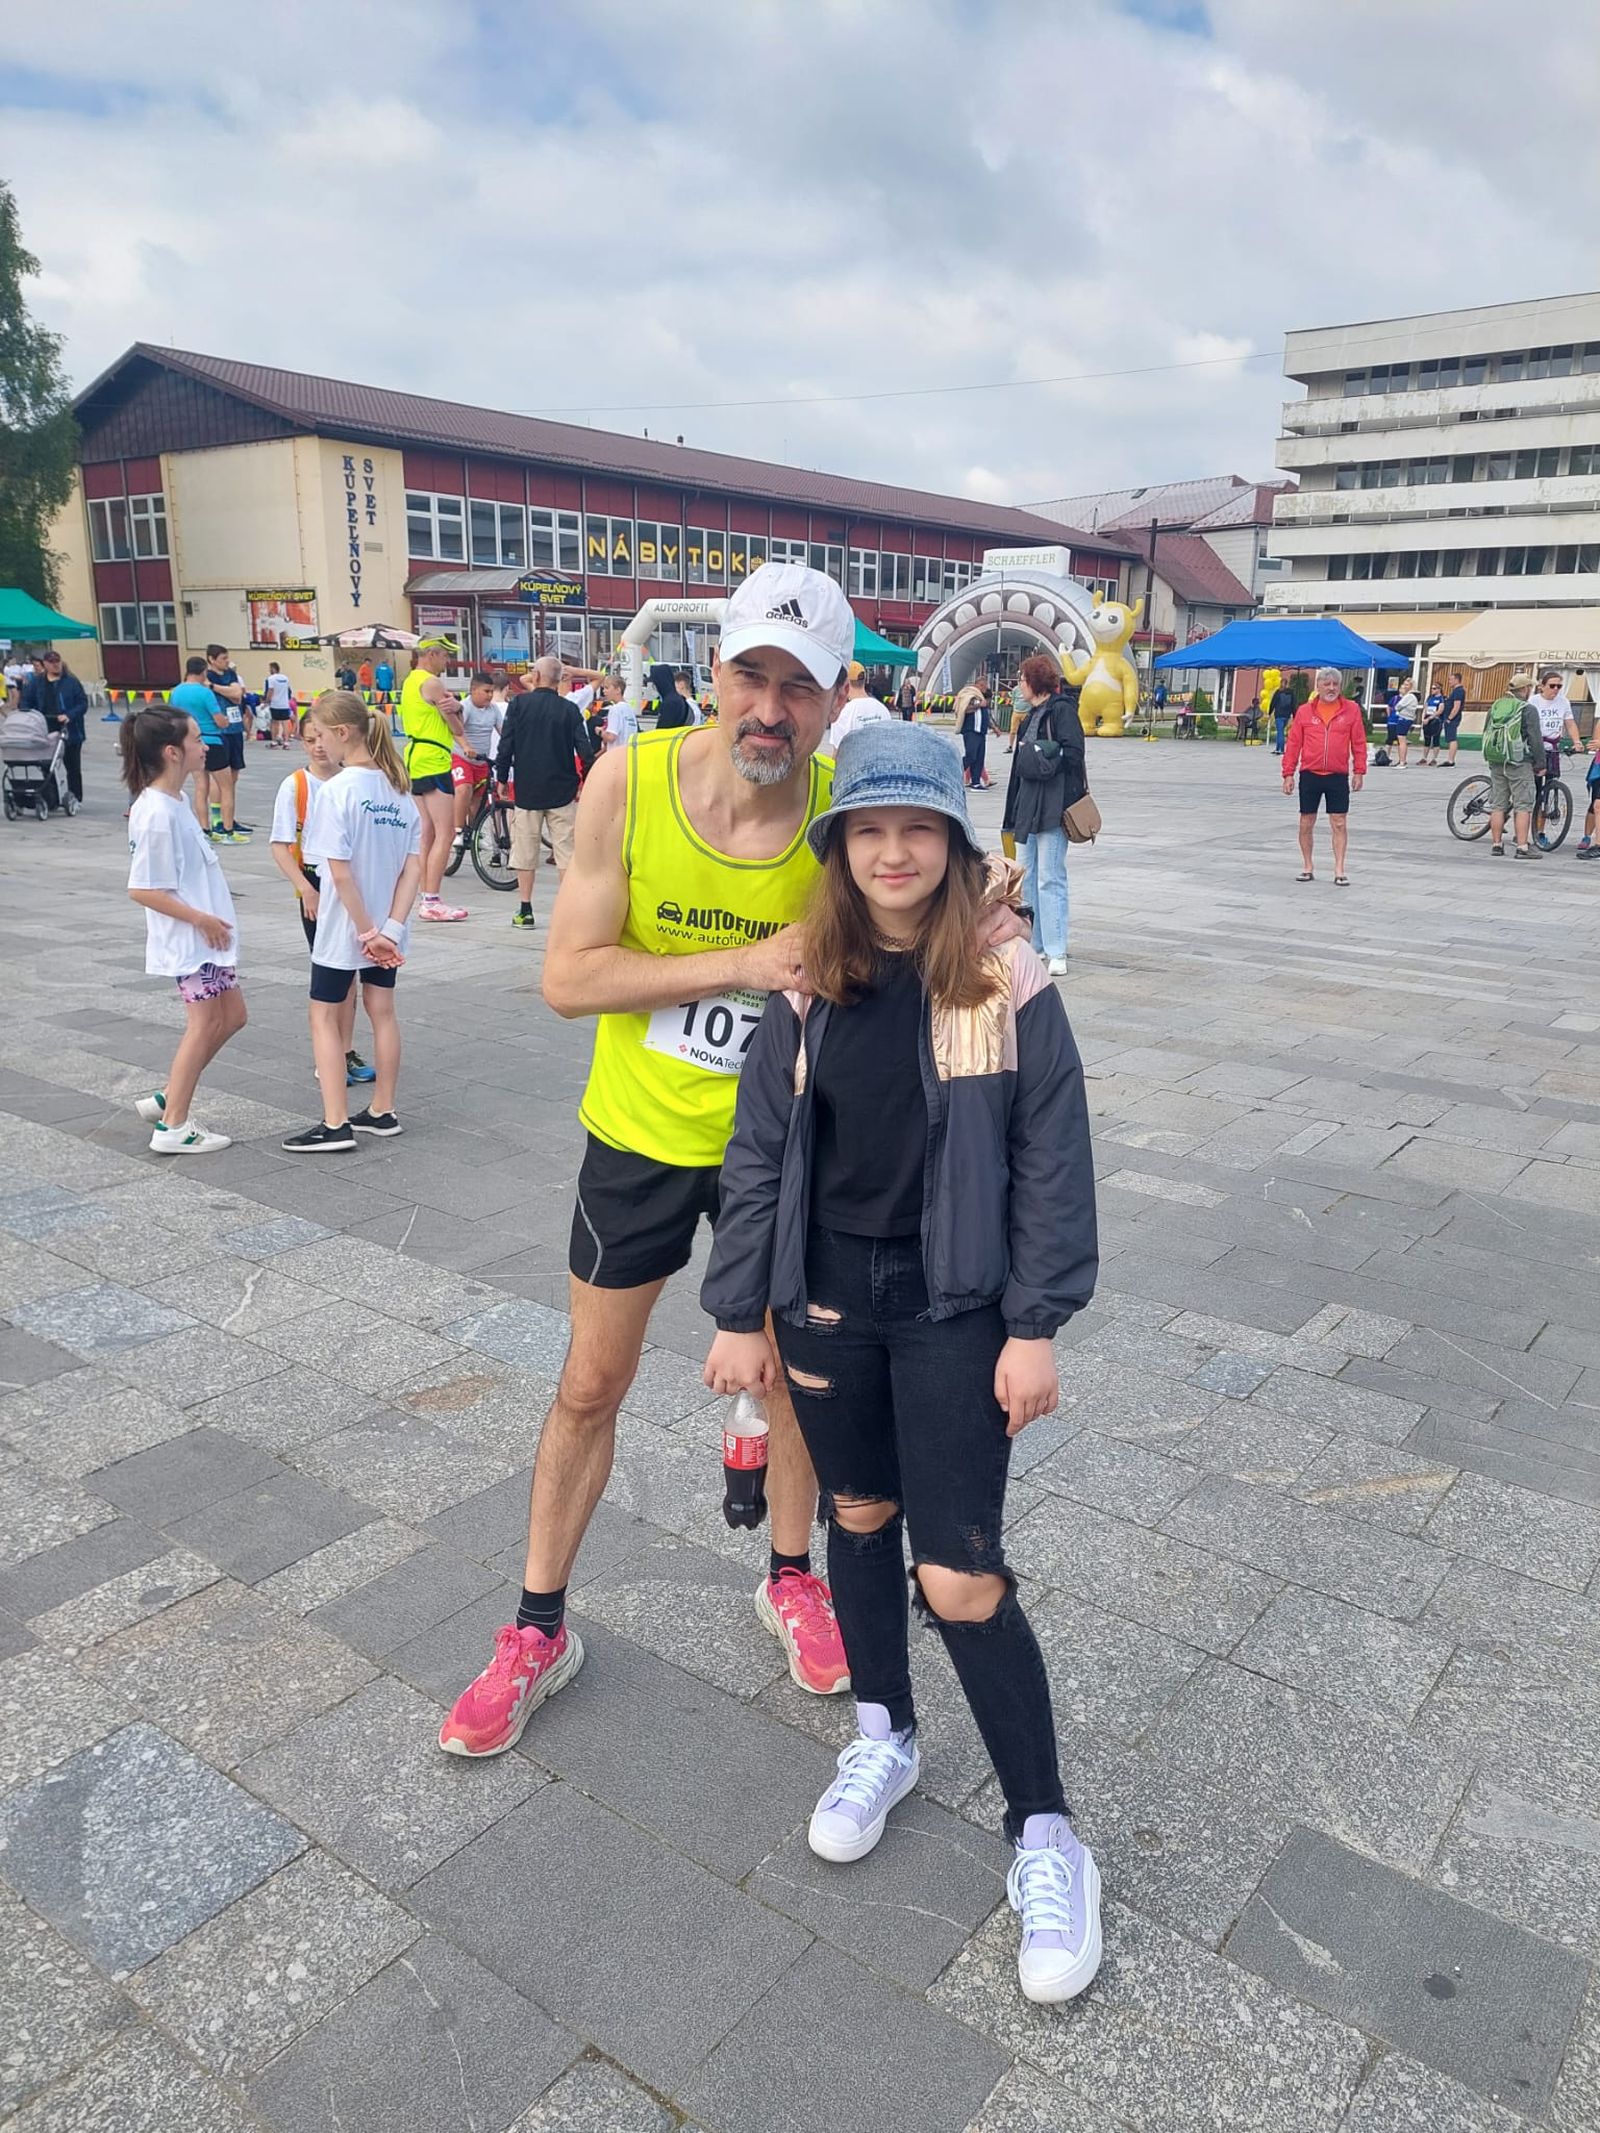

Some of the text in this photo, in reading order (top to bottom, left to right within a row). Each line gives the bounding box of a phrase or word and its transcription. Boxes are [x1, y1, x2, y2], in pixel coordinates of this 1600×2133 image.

[363, 458, 377, 525] SVET
[588, 532, 745, 573] NÁBYTOK
[987, 553, 1056, 566] SCHAEFFLER
[540, 593, 566, 604] SVET
[654, 602, 709, 613] AUTOPROFIT
[765, 610, 809, 629] adidas
[678, 1000, 762, 1053] 107
